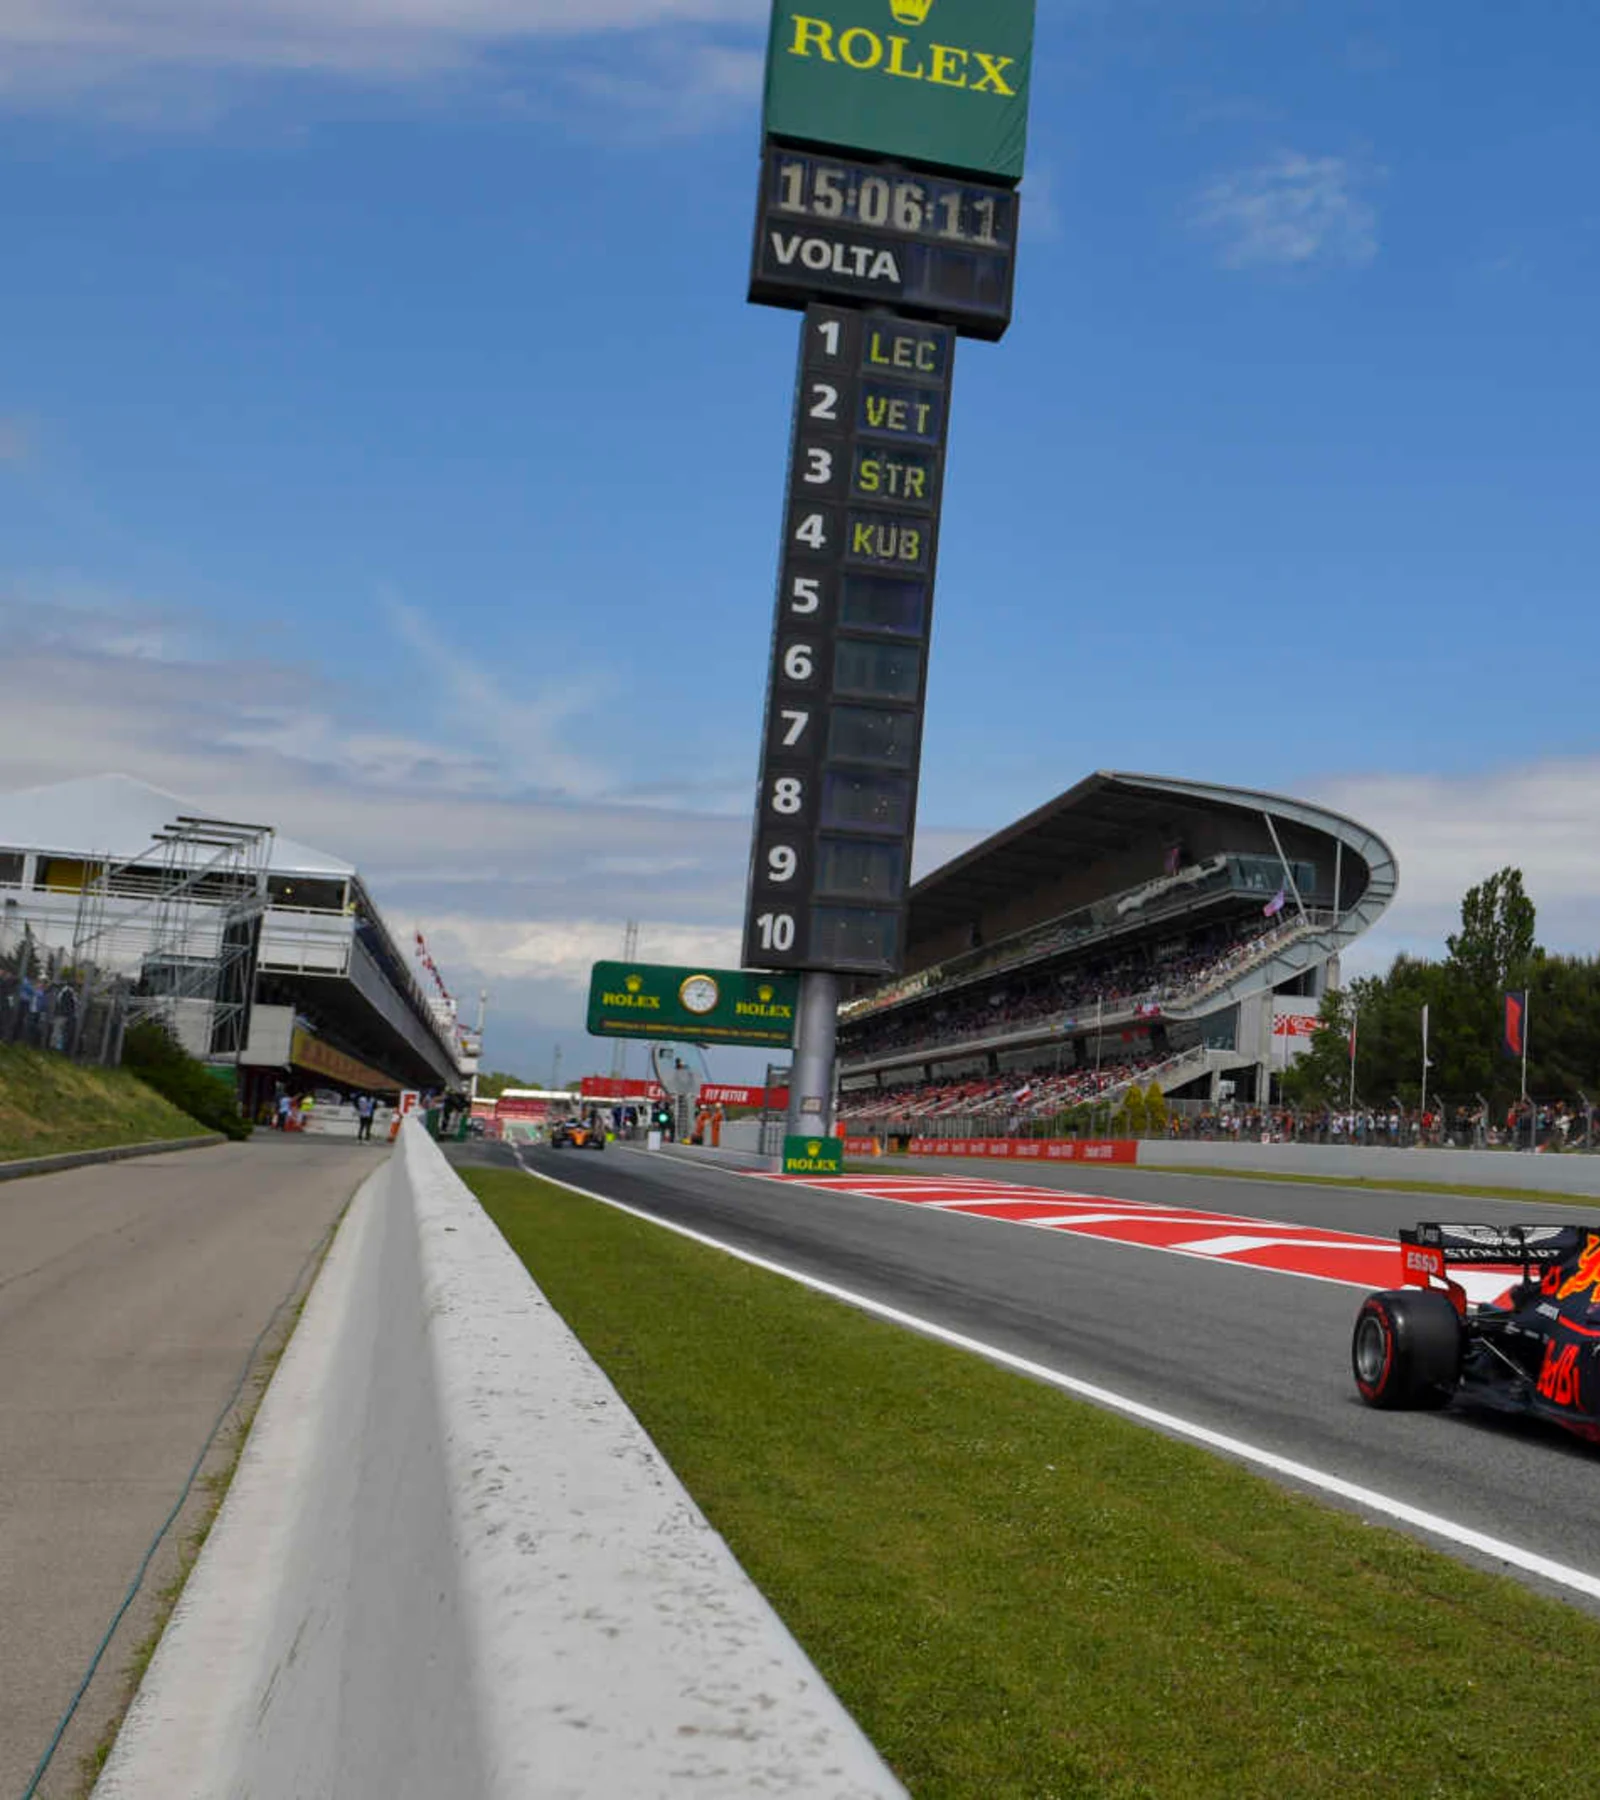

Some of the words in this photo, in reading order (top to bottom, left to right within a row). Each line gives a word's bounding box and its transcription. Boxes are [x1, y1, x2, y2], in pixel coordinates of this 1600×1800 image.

[788, 14, 1016, 95] ROLEX
[779, 162, 1001, 245] 15:06:11
[771, 232, 901, 283] VOLTA
[817, 321, 840, 355] 1
[870, 333, 936, 371] LEC
[810, 385, 837, 420] 2
[866, 396, 930, 434] VET
[804, 449, 832, 484] 3
[860, 460, 926, 498] STR
[795, 514, 826, 549] 4
[852, 522, 920, 560] KUB
[791, 579, 819, 614] 5
[784, 645, 814, 680] 6
[780, 711, 809, 745] 7
[772, 778, 802, 814] 8
[768, 846, 797, 882] 9
[756, 914, 795, 951] 10
[602, 991, 660, 1009] ROLEX
[735, 1002, 791, 1018] ROLEX
[787, 1158, 836, 1171] ROLEX
[1407, 1251, 1438, 1273] ESSO
